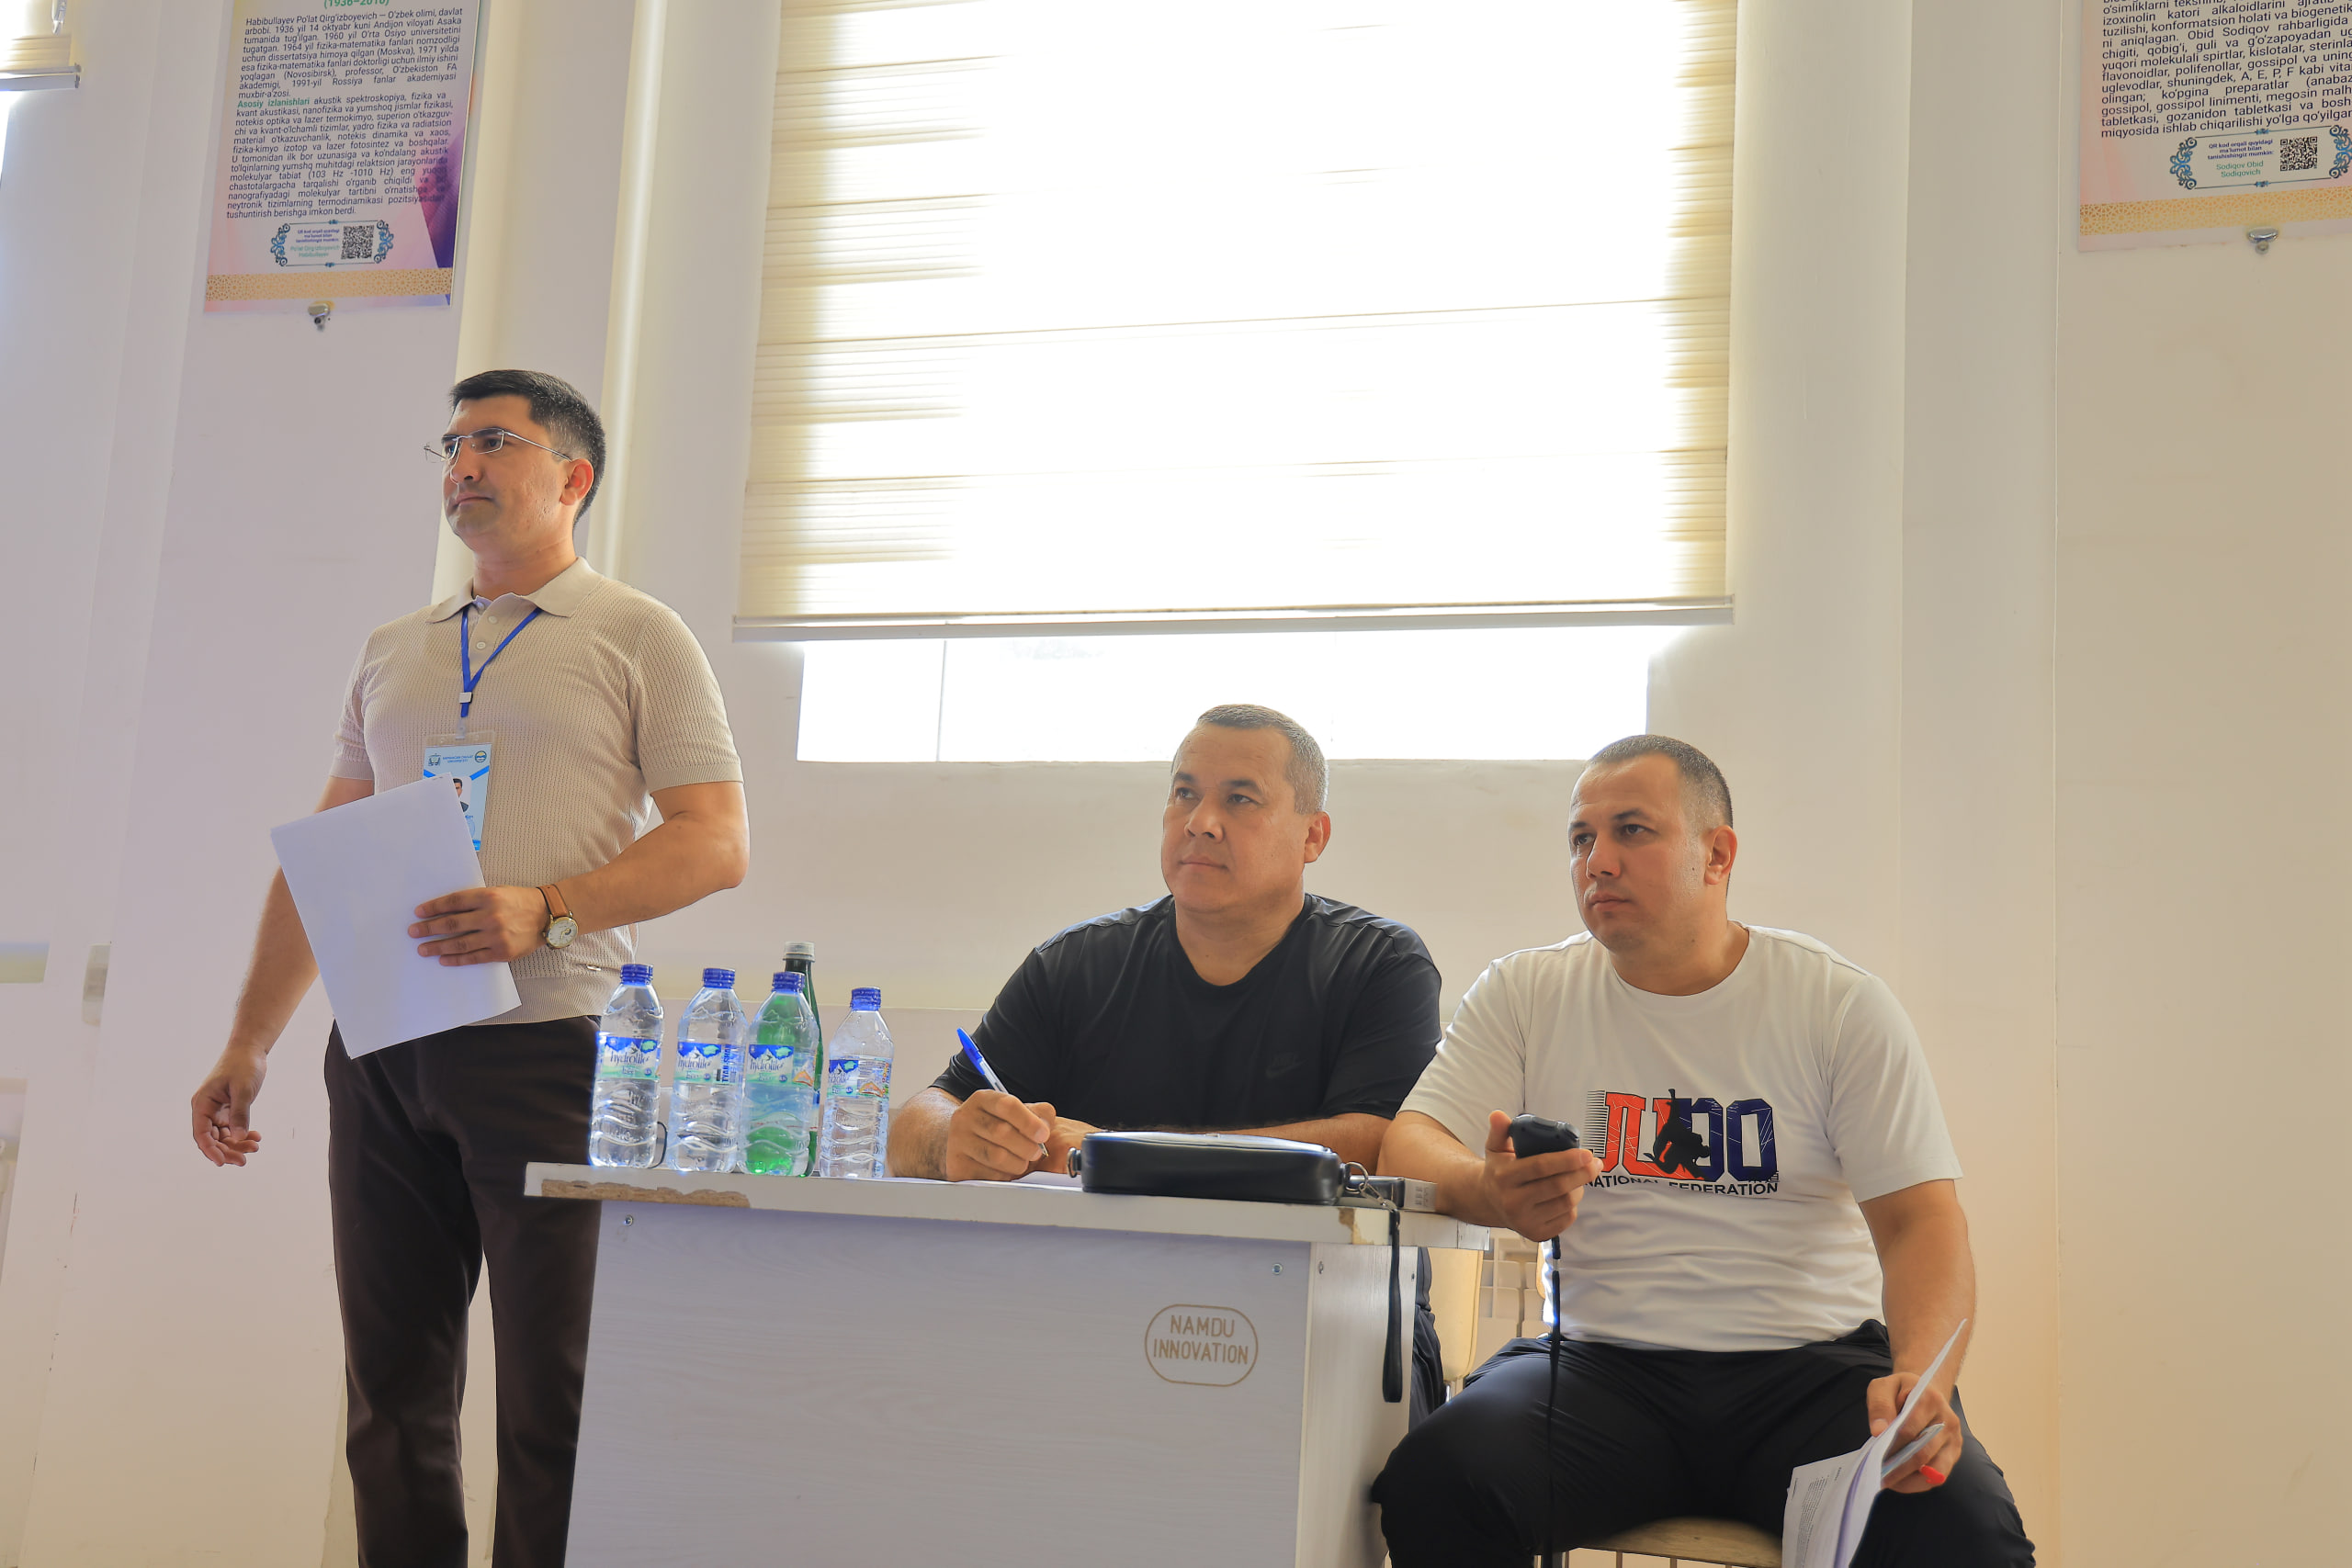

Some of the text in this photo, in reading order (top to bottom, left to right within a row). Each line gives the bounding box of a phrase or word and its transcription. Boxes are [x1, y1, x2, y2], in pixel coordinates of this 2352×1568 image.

[2103, 11, 2156, 25] izoxinolin
[2168, 6, 2200, 18] katori
[2212, 0, 2285, 14] alkaloidlarini
[2103, 23, 2148, 36] tuzilishi,
[2152, 16, 2235, 31] konformatsion
[2238, 11, 2271, 23] holati
[275, 25, 294, 33] 1936
[325, 31, 344, 39] 1960
[2102, 16, 2348, 47] ni aniqlagan. Obid Sodiqov rahbarligida
[283, 43, 302, 51] 1964
[419, 45, 437, 53] 1971
[2102, 46, 2139, 59] chigiti,
[2196, 39, 2217, 52] guli
[2102, 43, 2305, 71] yuqori molekulali spirtlar, kislotalar,
[2102, 67, 2170, 80] flavonoidlar,
[2176, 61, 2242, 76] polifenollar,
[2247, 55, 2297, 70] gossipol
[2102, 64, 2324, 94] uglevodlar, shuningdek, A, E, P, F kabi
[2102, 93, 2146, 104] olingan;
[2225, 80, 2289, 96] preparatlar
[2102, 101, 2152, 116] gossipol,
[2156, 96, 2205, 112] gossipol
[2209, 92, 2262, 105] linimenti,
[2266, 88, 2317, 101] megosin
[2102, 113, 2159, 126] tabletkasi,
[2166, 108, 2226, 123] gozanidon
[2234, 102, 2292, 115] tabletkasi
[2102, 124, 2159, 138] miqyosida
[2162, 120, 2197, 132] ishlab
[2200, 115, 2263, 130] chiqarilishi
[1589, 1091, 1778, 1182] JUDO
[1170, 1314, 1235, 1338] NAMDU
[1153, 1338, 1249, 1365] INNOVATION
